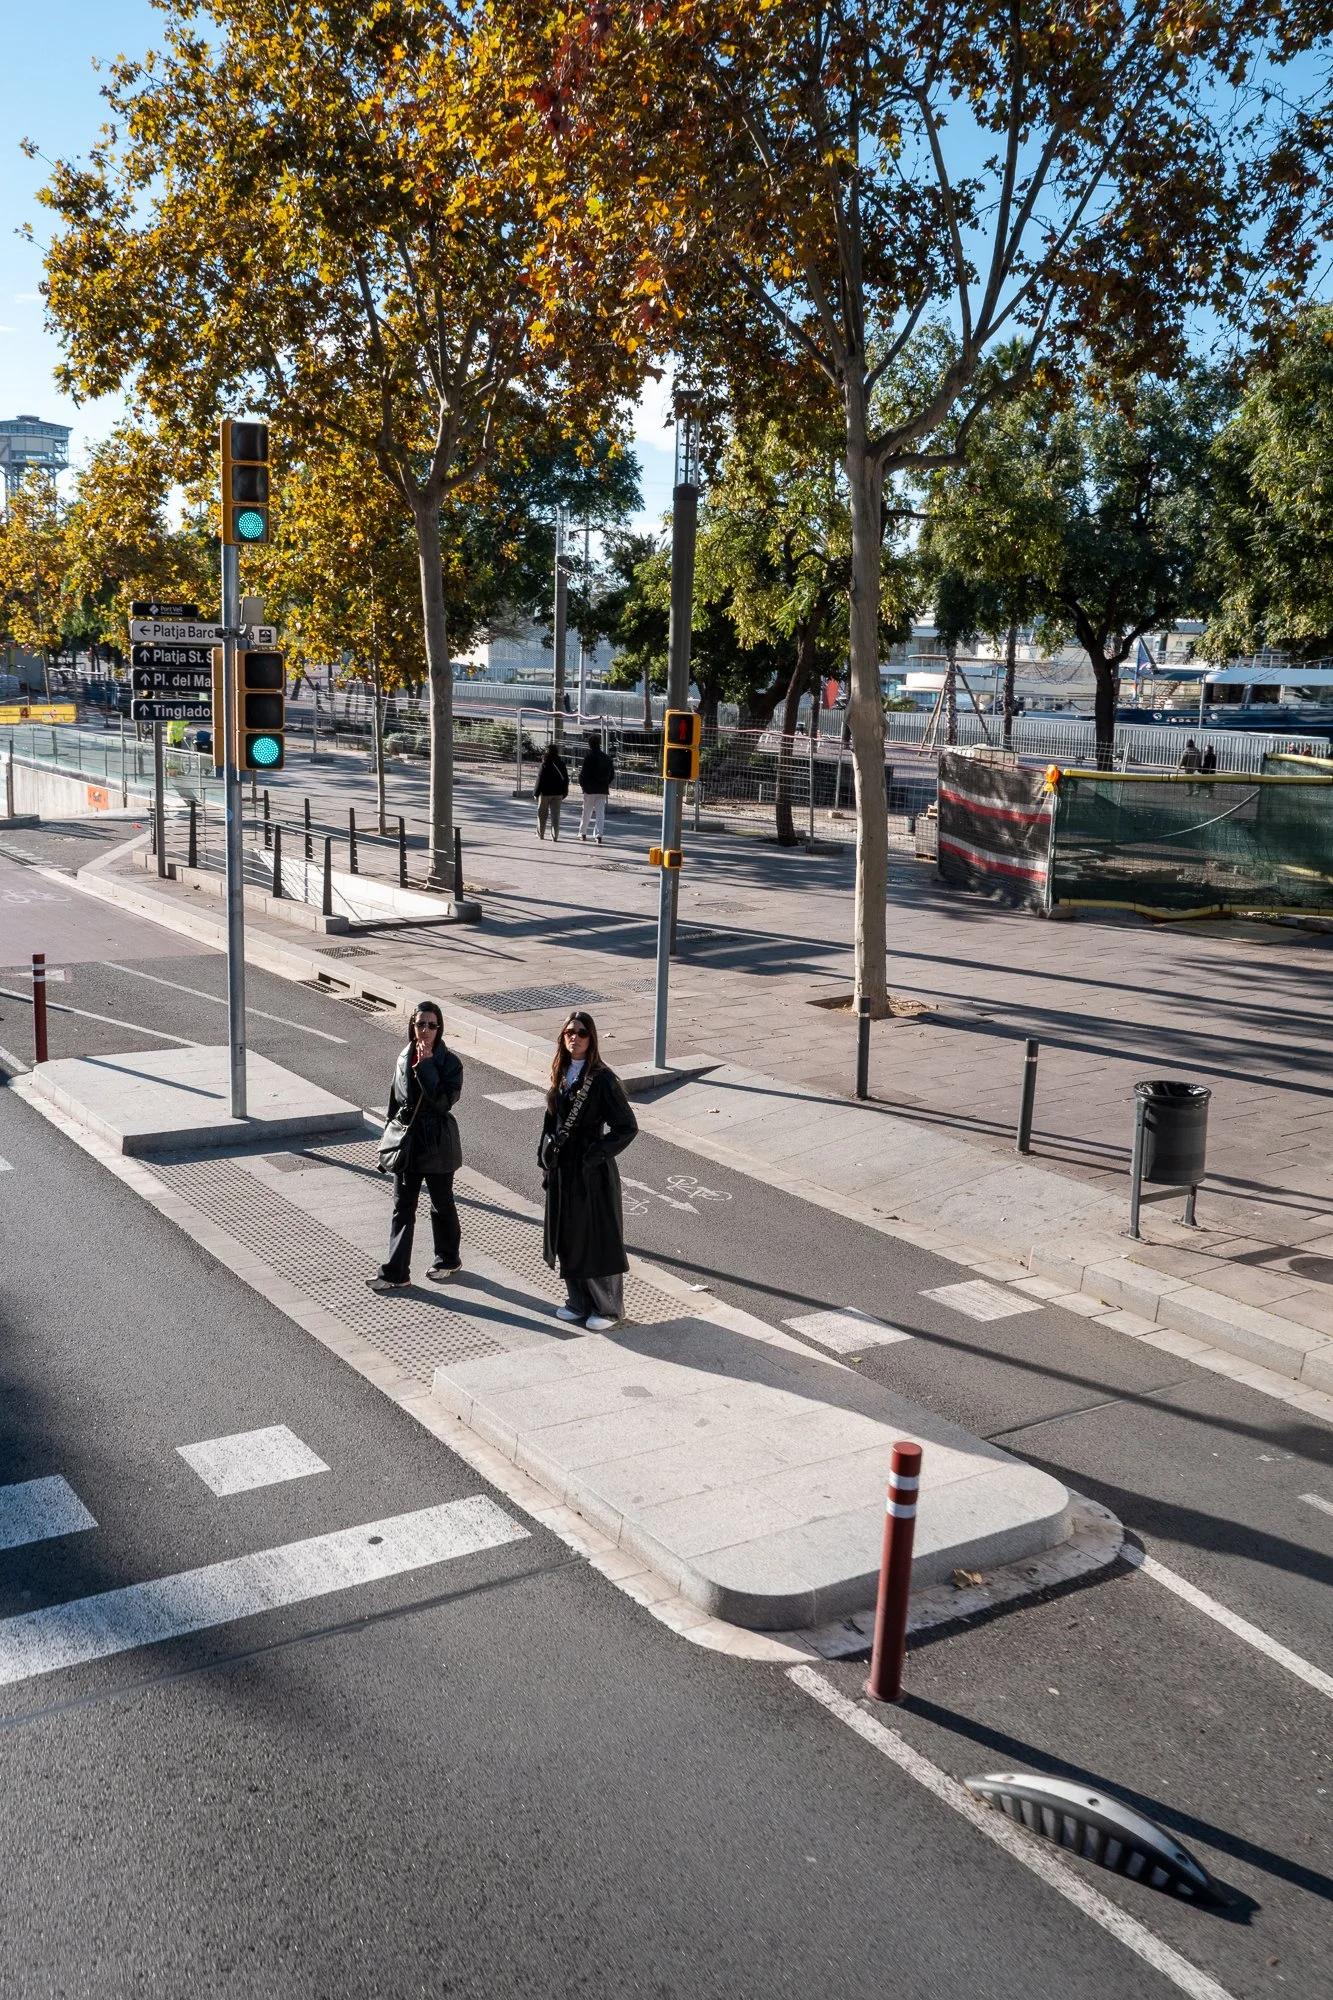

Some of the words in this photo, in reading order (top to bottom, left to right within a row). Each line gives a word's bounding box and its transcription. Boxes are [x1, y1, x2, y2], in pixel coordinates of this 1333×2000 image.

[153, 625, 186, 640] Platja
[153, 649, 187, 665] Platja
[188, 651, 204, 663] St.
[153, 673, 169, 686] Pl.
[172, 674, 191, 687] del
[153, 704, 212, 719] Tinglado
